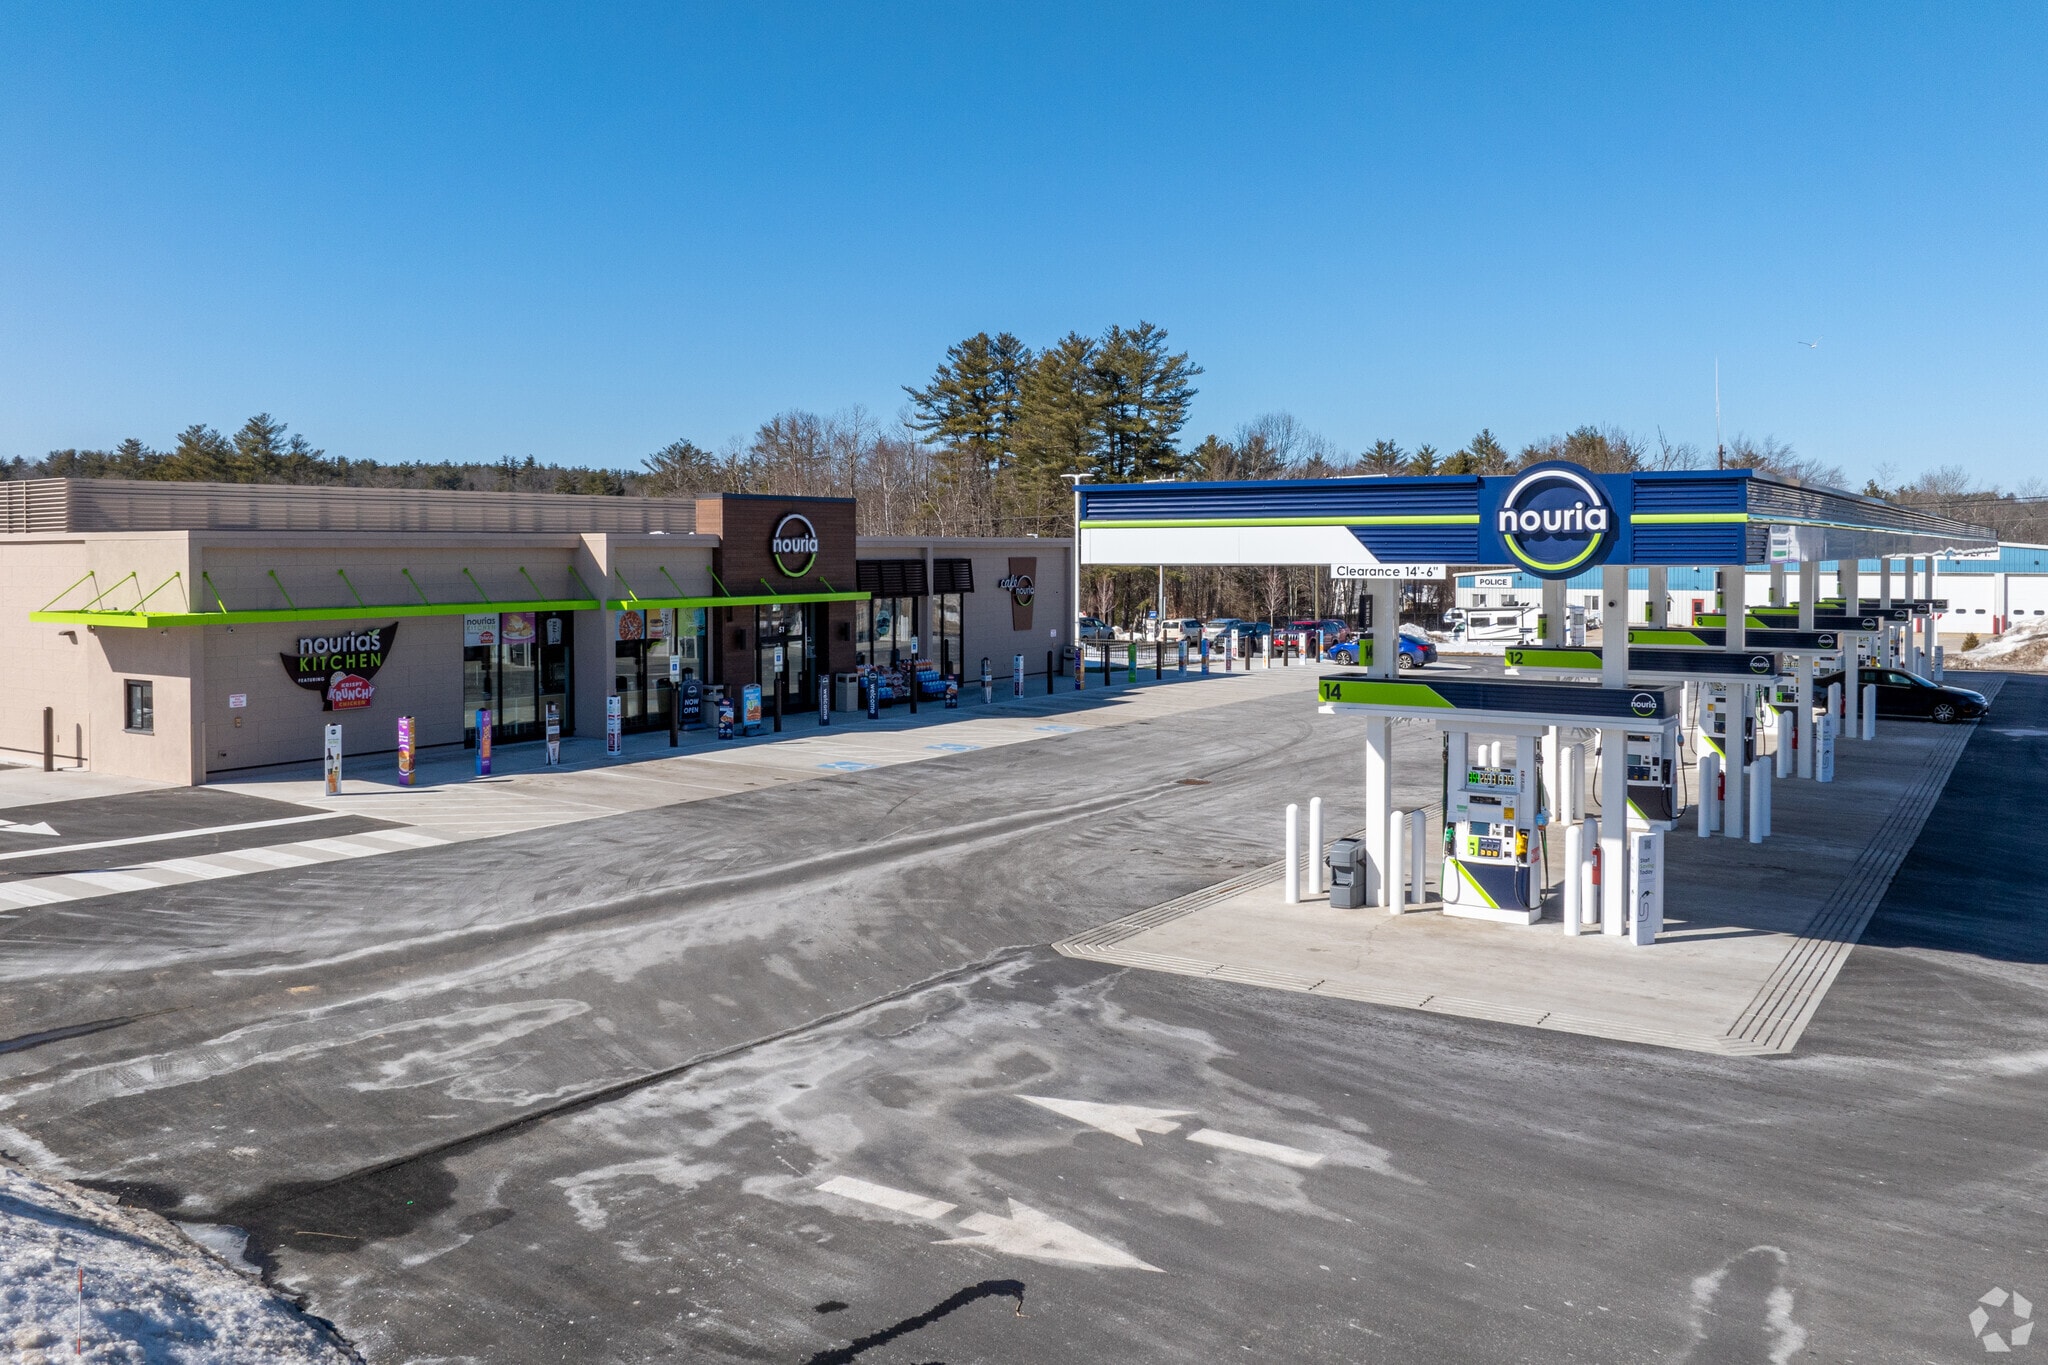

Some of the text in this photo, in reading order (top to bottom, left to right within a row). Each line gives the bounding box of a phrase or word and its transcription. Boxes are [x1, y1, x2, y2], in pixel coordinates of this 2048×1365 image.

[1499, 501, 1607, 531] nouria
[772, 533, 818, 553] nouria
[1336, 566, 1400, 576] Clearance
[1479, 578, 1508, 586] POLICE
[1016, 586, 1035, 595] nouria
[1696, 616, 1703, 626] 8
[300, 653, 381, 672] KITCHEN
[1508, 651, 1523, 665] 12
[1750, 660, 1770, 668] nouria
[329, 686, 377, 702] KRUNCHY
[1323, 683, 1342, 700] 14
[684, 698, 699, 706] NOW
[1631, 700, 1657, 708] nouria
[683, 706, 699, 714] OPEN
